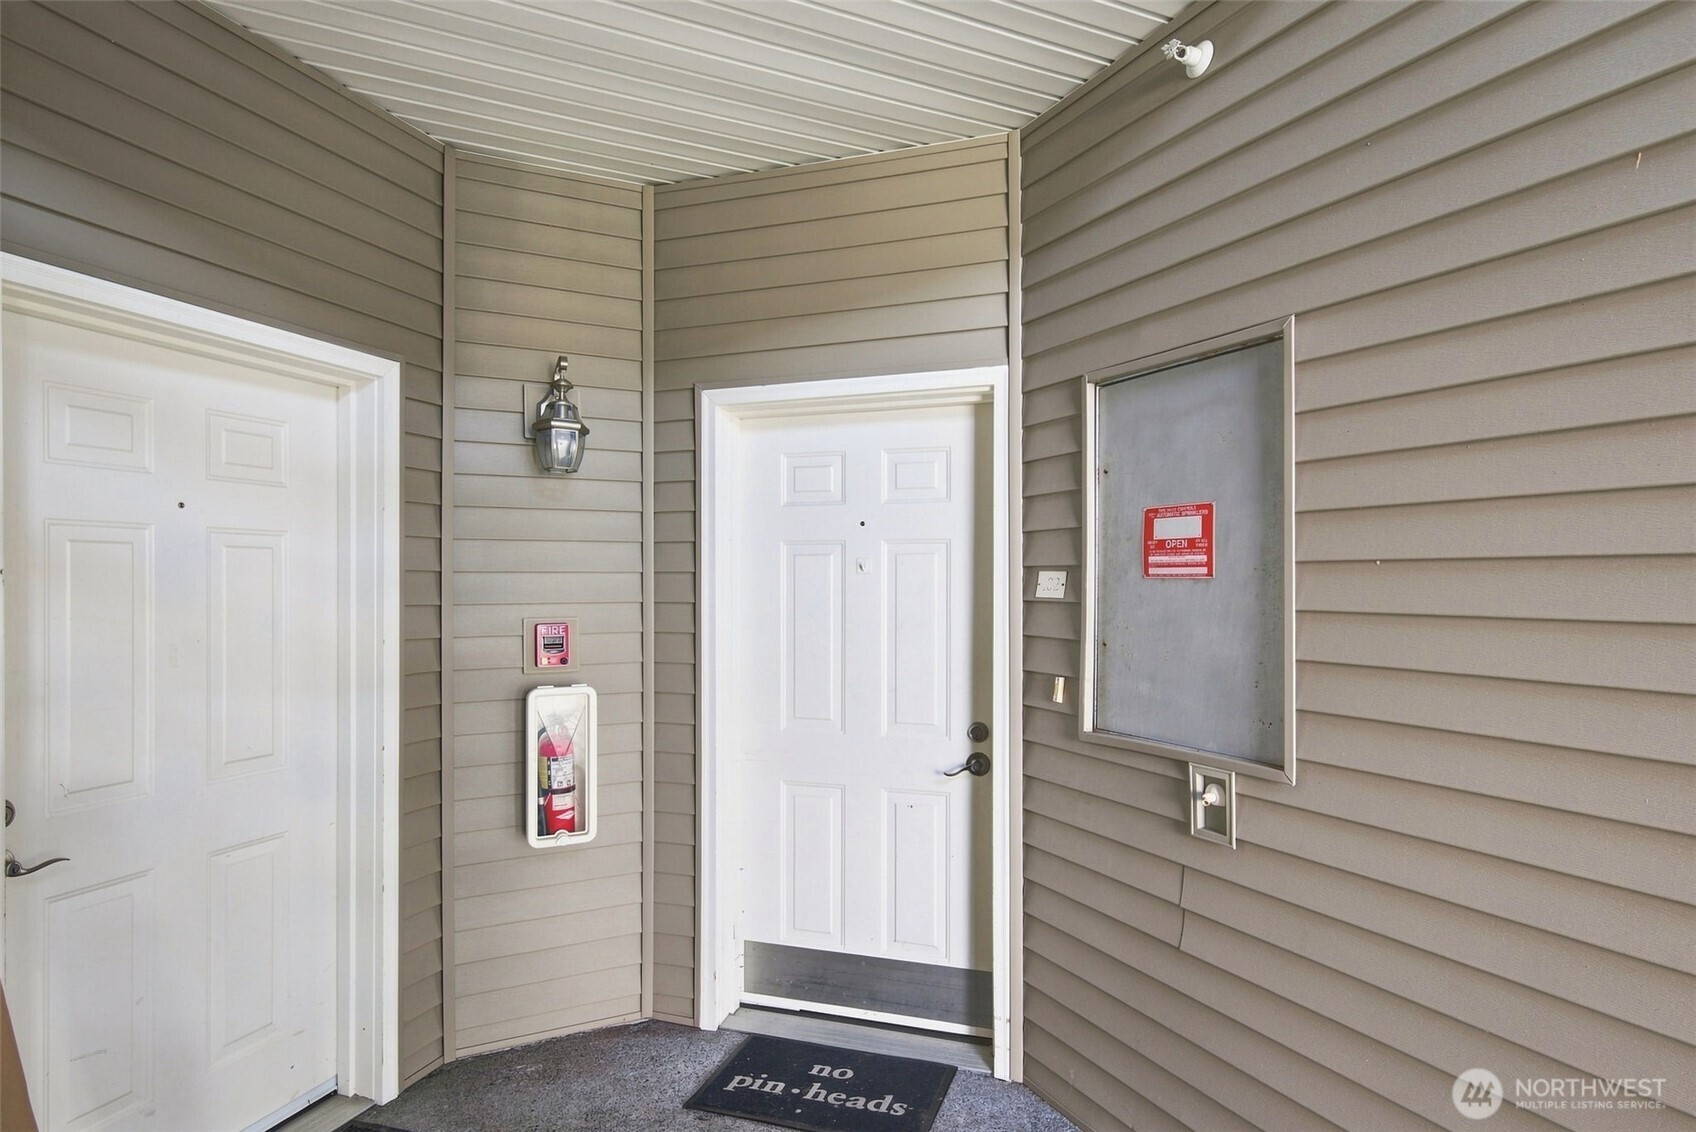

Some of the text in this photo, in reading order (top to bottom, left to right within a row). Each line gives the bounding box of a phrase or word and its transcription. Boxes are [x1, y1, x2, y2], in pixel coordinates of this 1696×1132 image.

[1165, 539, 1188, 549] OPEN
[541, 625, 566, 636] FIRE
[808, 1064, 854, 1080] no
